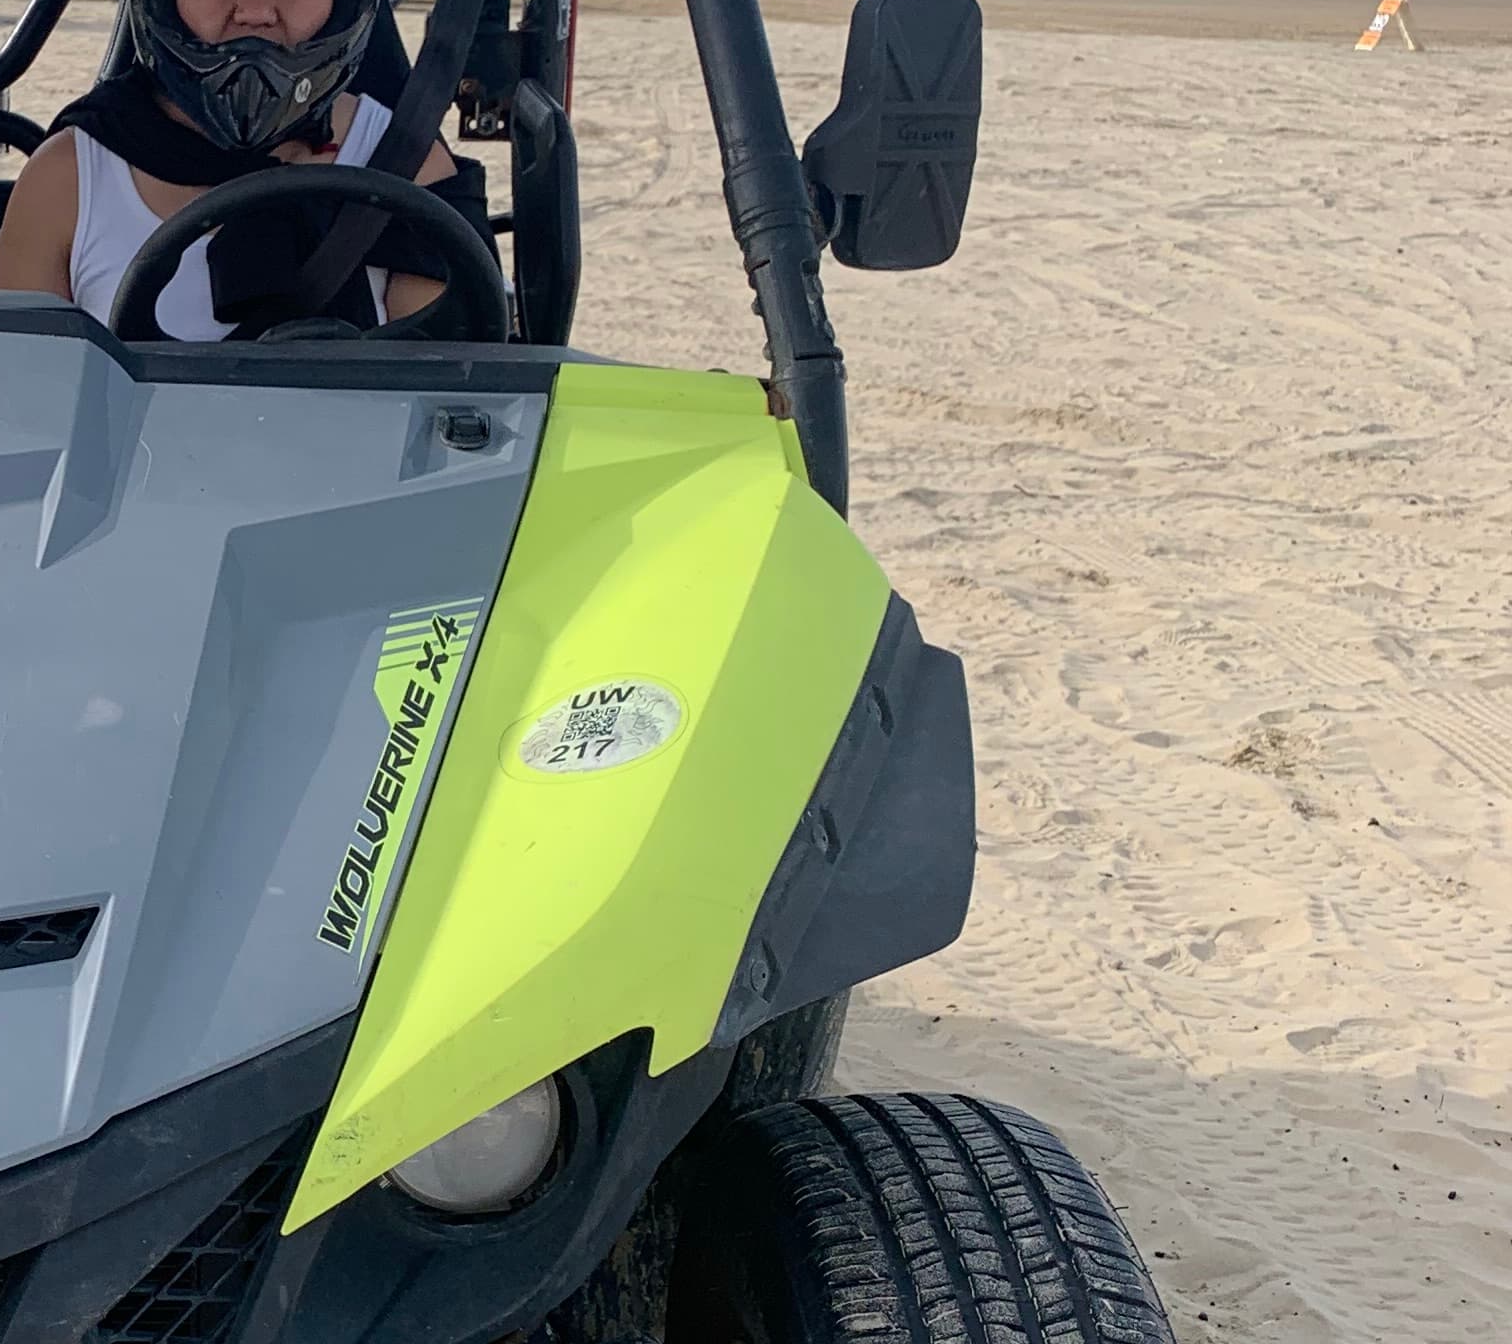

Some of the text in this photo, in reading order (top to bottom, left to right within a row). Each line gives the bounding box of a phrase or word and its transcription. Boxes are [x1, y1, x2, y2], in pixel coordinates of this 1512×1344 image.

[571, 686, 636, 710] UW
[546, 738, 615, 764] 217
[319, 679, 436, 951] WOLVERINE
